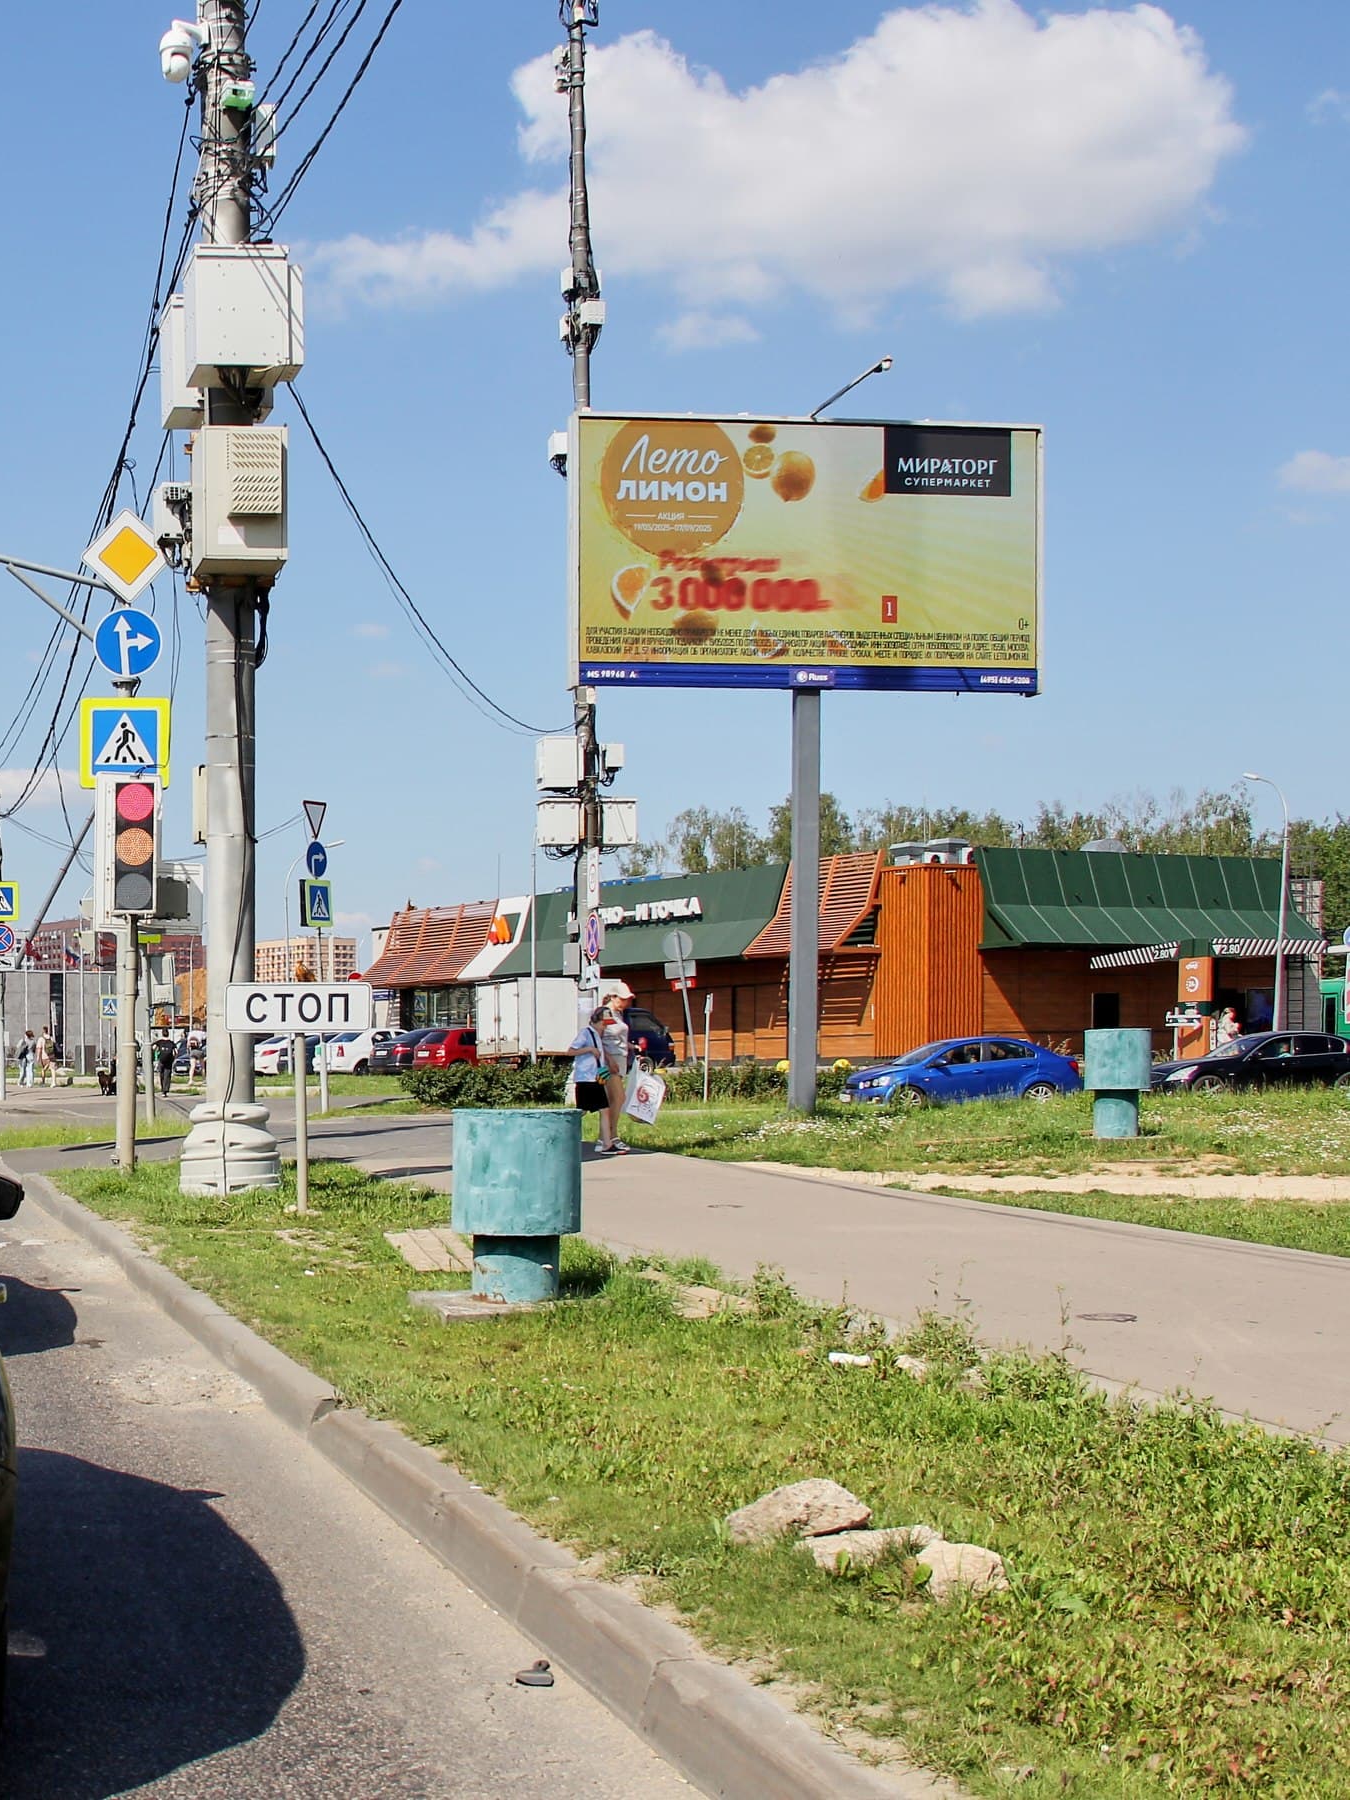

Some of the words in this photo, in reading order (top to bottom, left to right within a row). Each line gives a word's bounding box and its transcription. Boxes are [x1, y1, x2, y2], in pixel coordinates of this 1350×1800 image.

[621, 434, 729, 475] Лето
[897, 457, 999, 475] МИРАТОРГ
[904, 477, 991, 488] СУПЕРМАРКЕТ
[616, 480, 728, 502] ЛИМОН
[657, 512, 685, 521] АКЦИЯ
[886, 601, 893, 617] 1
[1018, 617, 1030, 630] 0+
[650, 897, 702, 919] ТОЧКА
[1154, 948, 1170, 960] 2.80
[1221, 944, 1241, 955] 2.80
[246, 993, 349, 1022] СТОП
